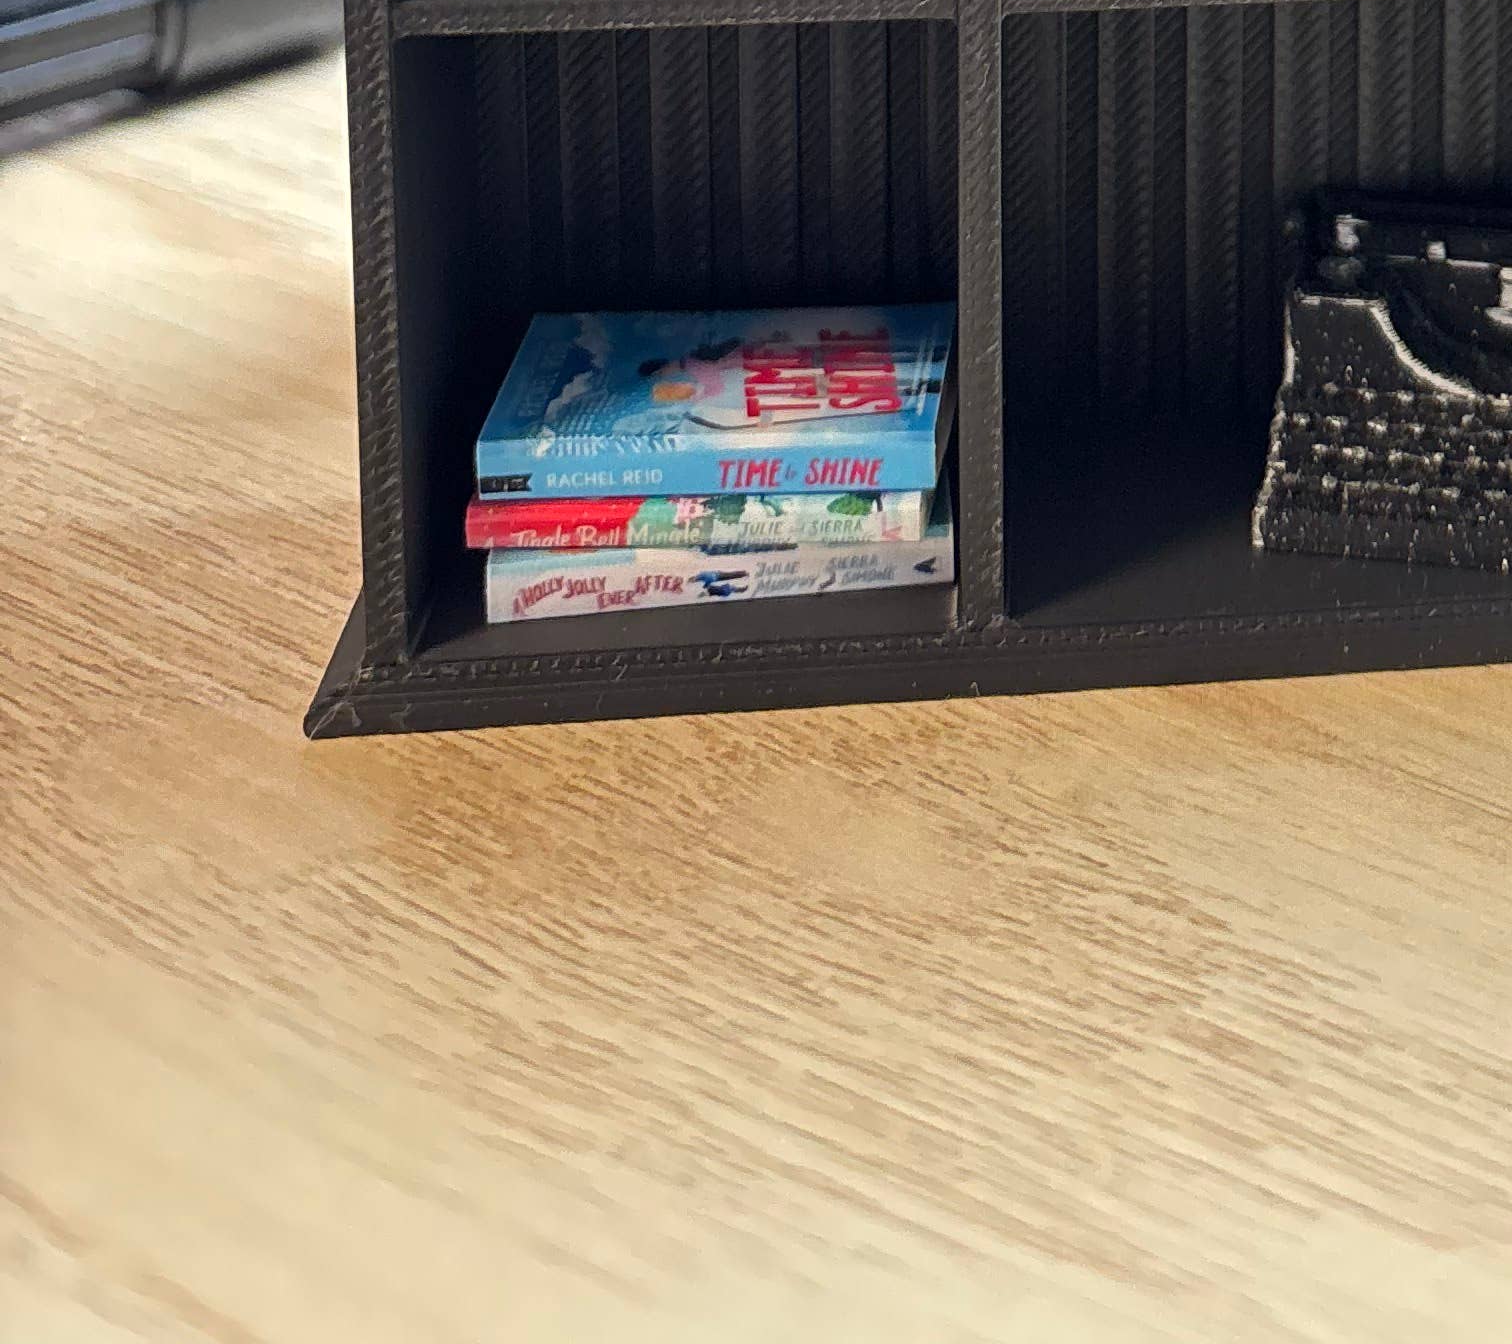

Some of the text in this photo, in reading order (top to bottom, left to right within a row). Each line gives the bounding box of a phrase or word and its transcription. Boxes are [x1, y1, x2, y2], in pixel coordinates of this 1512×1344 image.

[546, 469, 617, 489] RACHEL
[623, 467, 663, 485] REID
[718, 458, 783, 489] TIME
[804, 457, 884, 487] SHINE
[811, 518, 865, 535] SIERRA
[522, 575, 565, 607] HOLLY
[562, 575, 608, 600] JOLLY
[596, 589, 638, 611] EVER
[634, 574, 685, 596] AFTER
